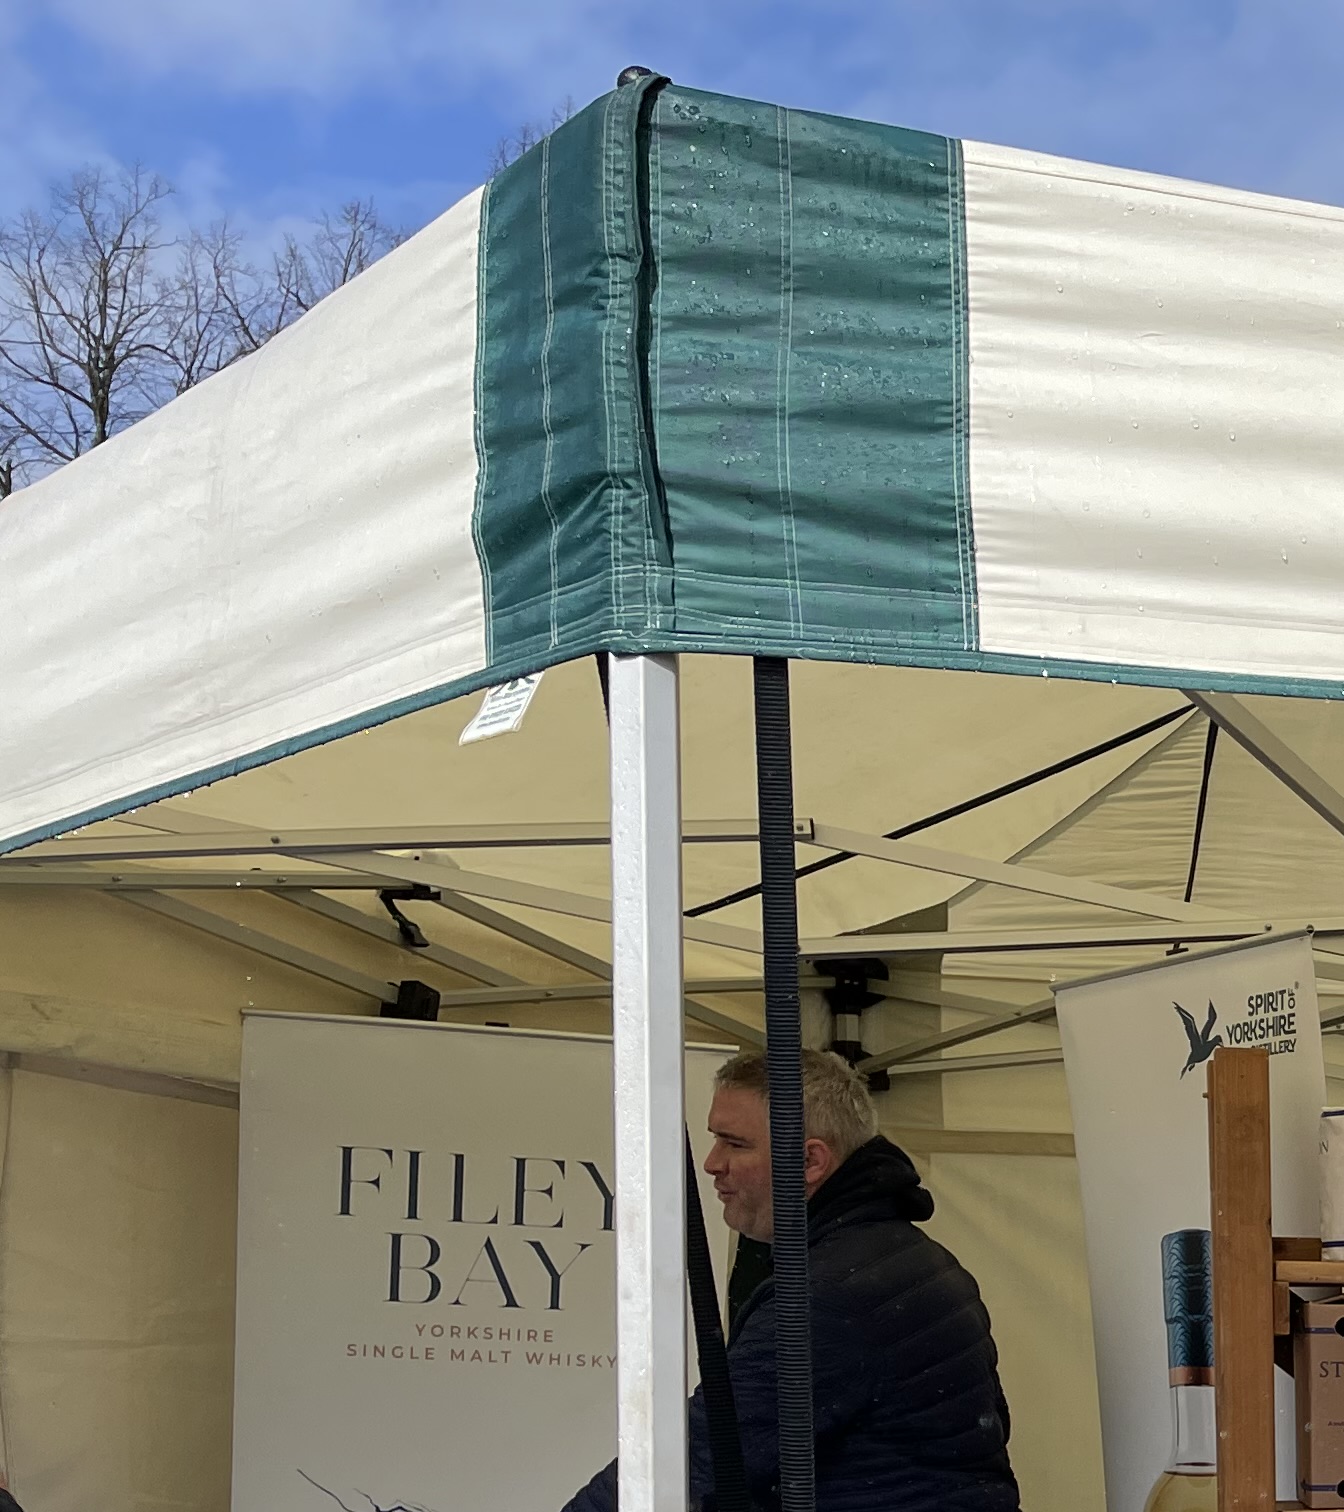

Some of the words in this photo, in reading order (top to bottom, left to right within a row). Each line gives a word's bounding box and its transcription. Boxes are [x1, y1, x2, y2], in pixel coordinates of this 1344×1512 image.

[1247, 989, 1287, 1016] SPIRIT
[1226, 1012, 1297, 1045] YORKSHIRE
[333, 1145, 615, 1231] FILEY
[382, 1232, 594, 1311] BAY
[415, 1323, 554, 1343] YORKSHIRE
[346, 1343, 436, 1361] SINGLE
[450, 1349, 512, 1364] MALT
[525, 1351, 617, 1369] WHISKY
